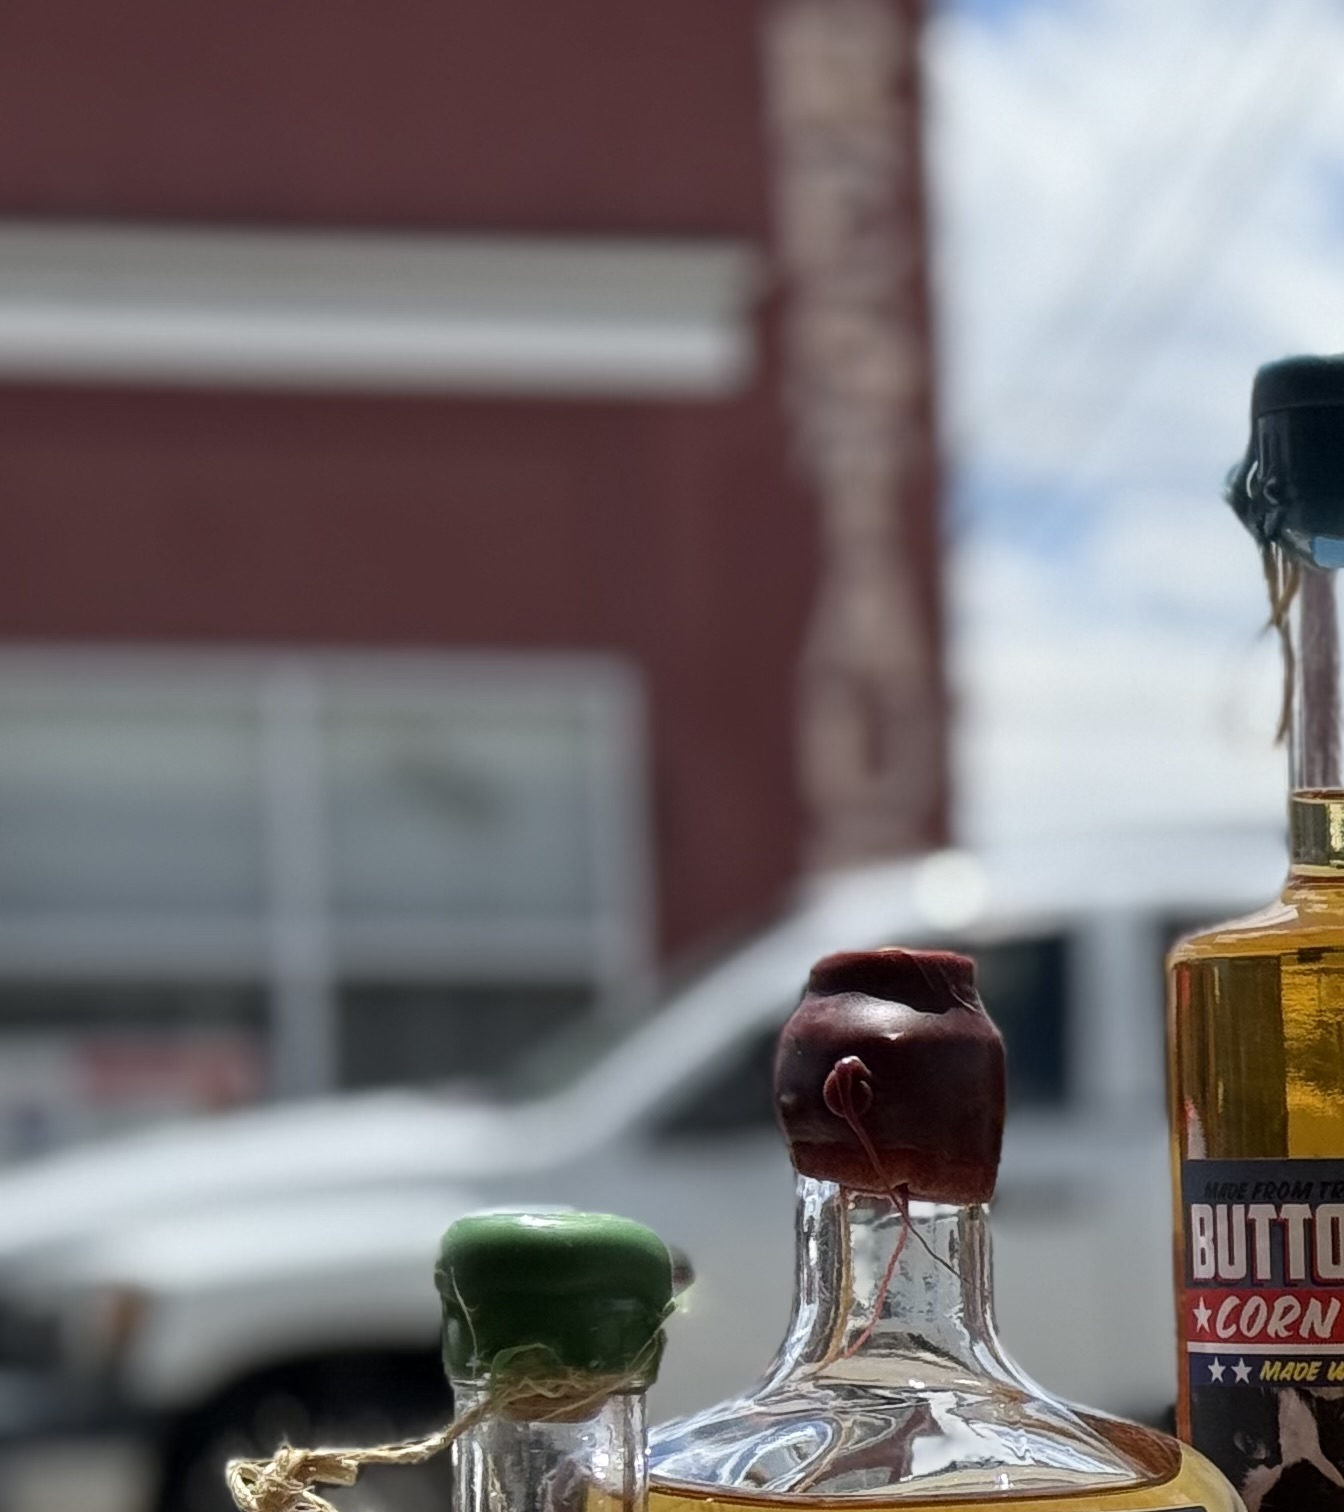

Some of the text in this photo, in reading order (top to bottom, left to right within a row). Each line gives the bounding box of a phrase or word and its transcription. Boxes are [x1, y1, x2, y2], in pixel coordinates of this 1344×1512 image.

[1205, 1182, 1247, 1199] MADE
[1253, 1182, 1315, 1199] FROM
[1215, 1295, 1340, 1340] CORN
[1259, 1359, 1320, 1382] MADE
